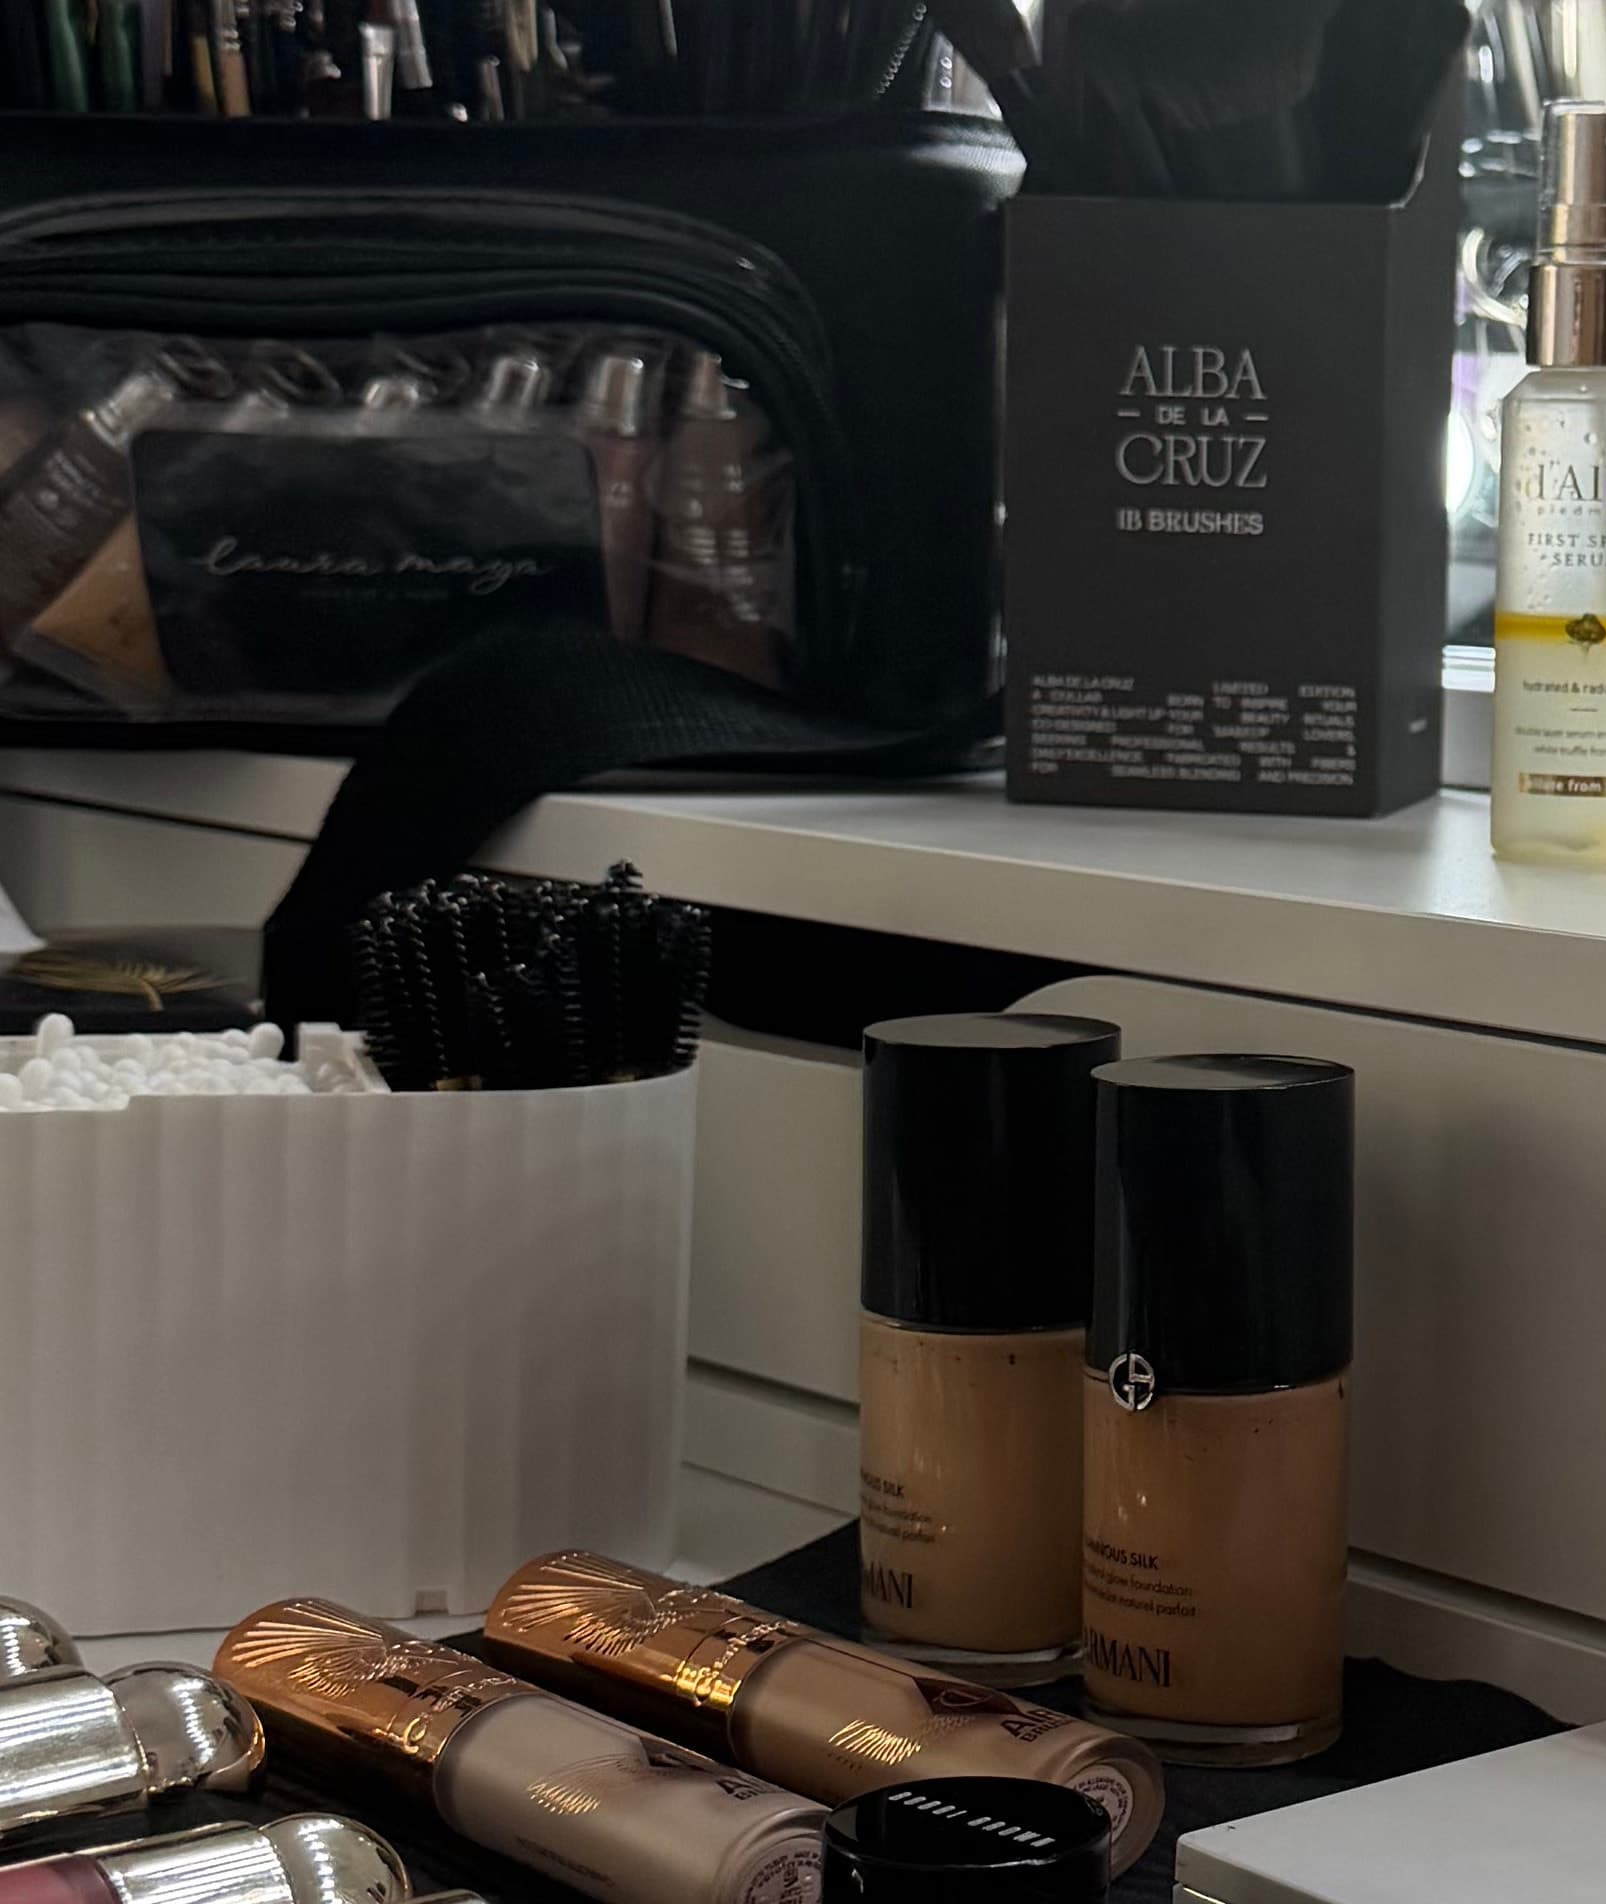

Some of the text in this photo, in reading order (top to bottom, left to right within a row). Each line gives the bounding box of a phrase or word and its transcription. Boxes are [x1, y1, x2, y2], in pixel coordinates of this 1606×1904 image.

[1119, 345, 1267, 399] ALBA
[1157, 406, 1230, 426] DE LA
[1116, 433, 1268, 488] CRUZ
[1147, 509, 1264, 536] BRUSHES
[1528, 533, 1579, 548] FIRST
[1567, 778, 1602, 793] from
[1130, 1552, 1160, 1571] SILK
[888, 1791, 1056, 1847] BOBBI BROWN
